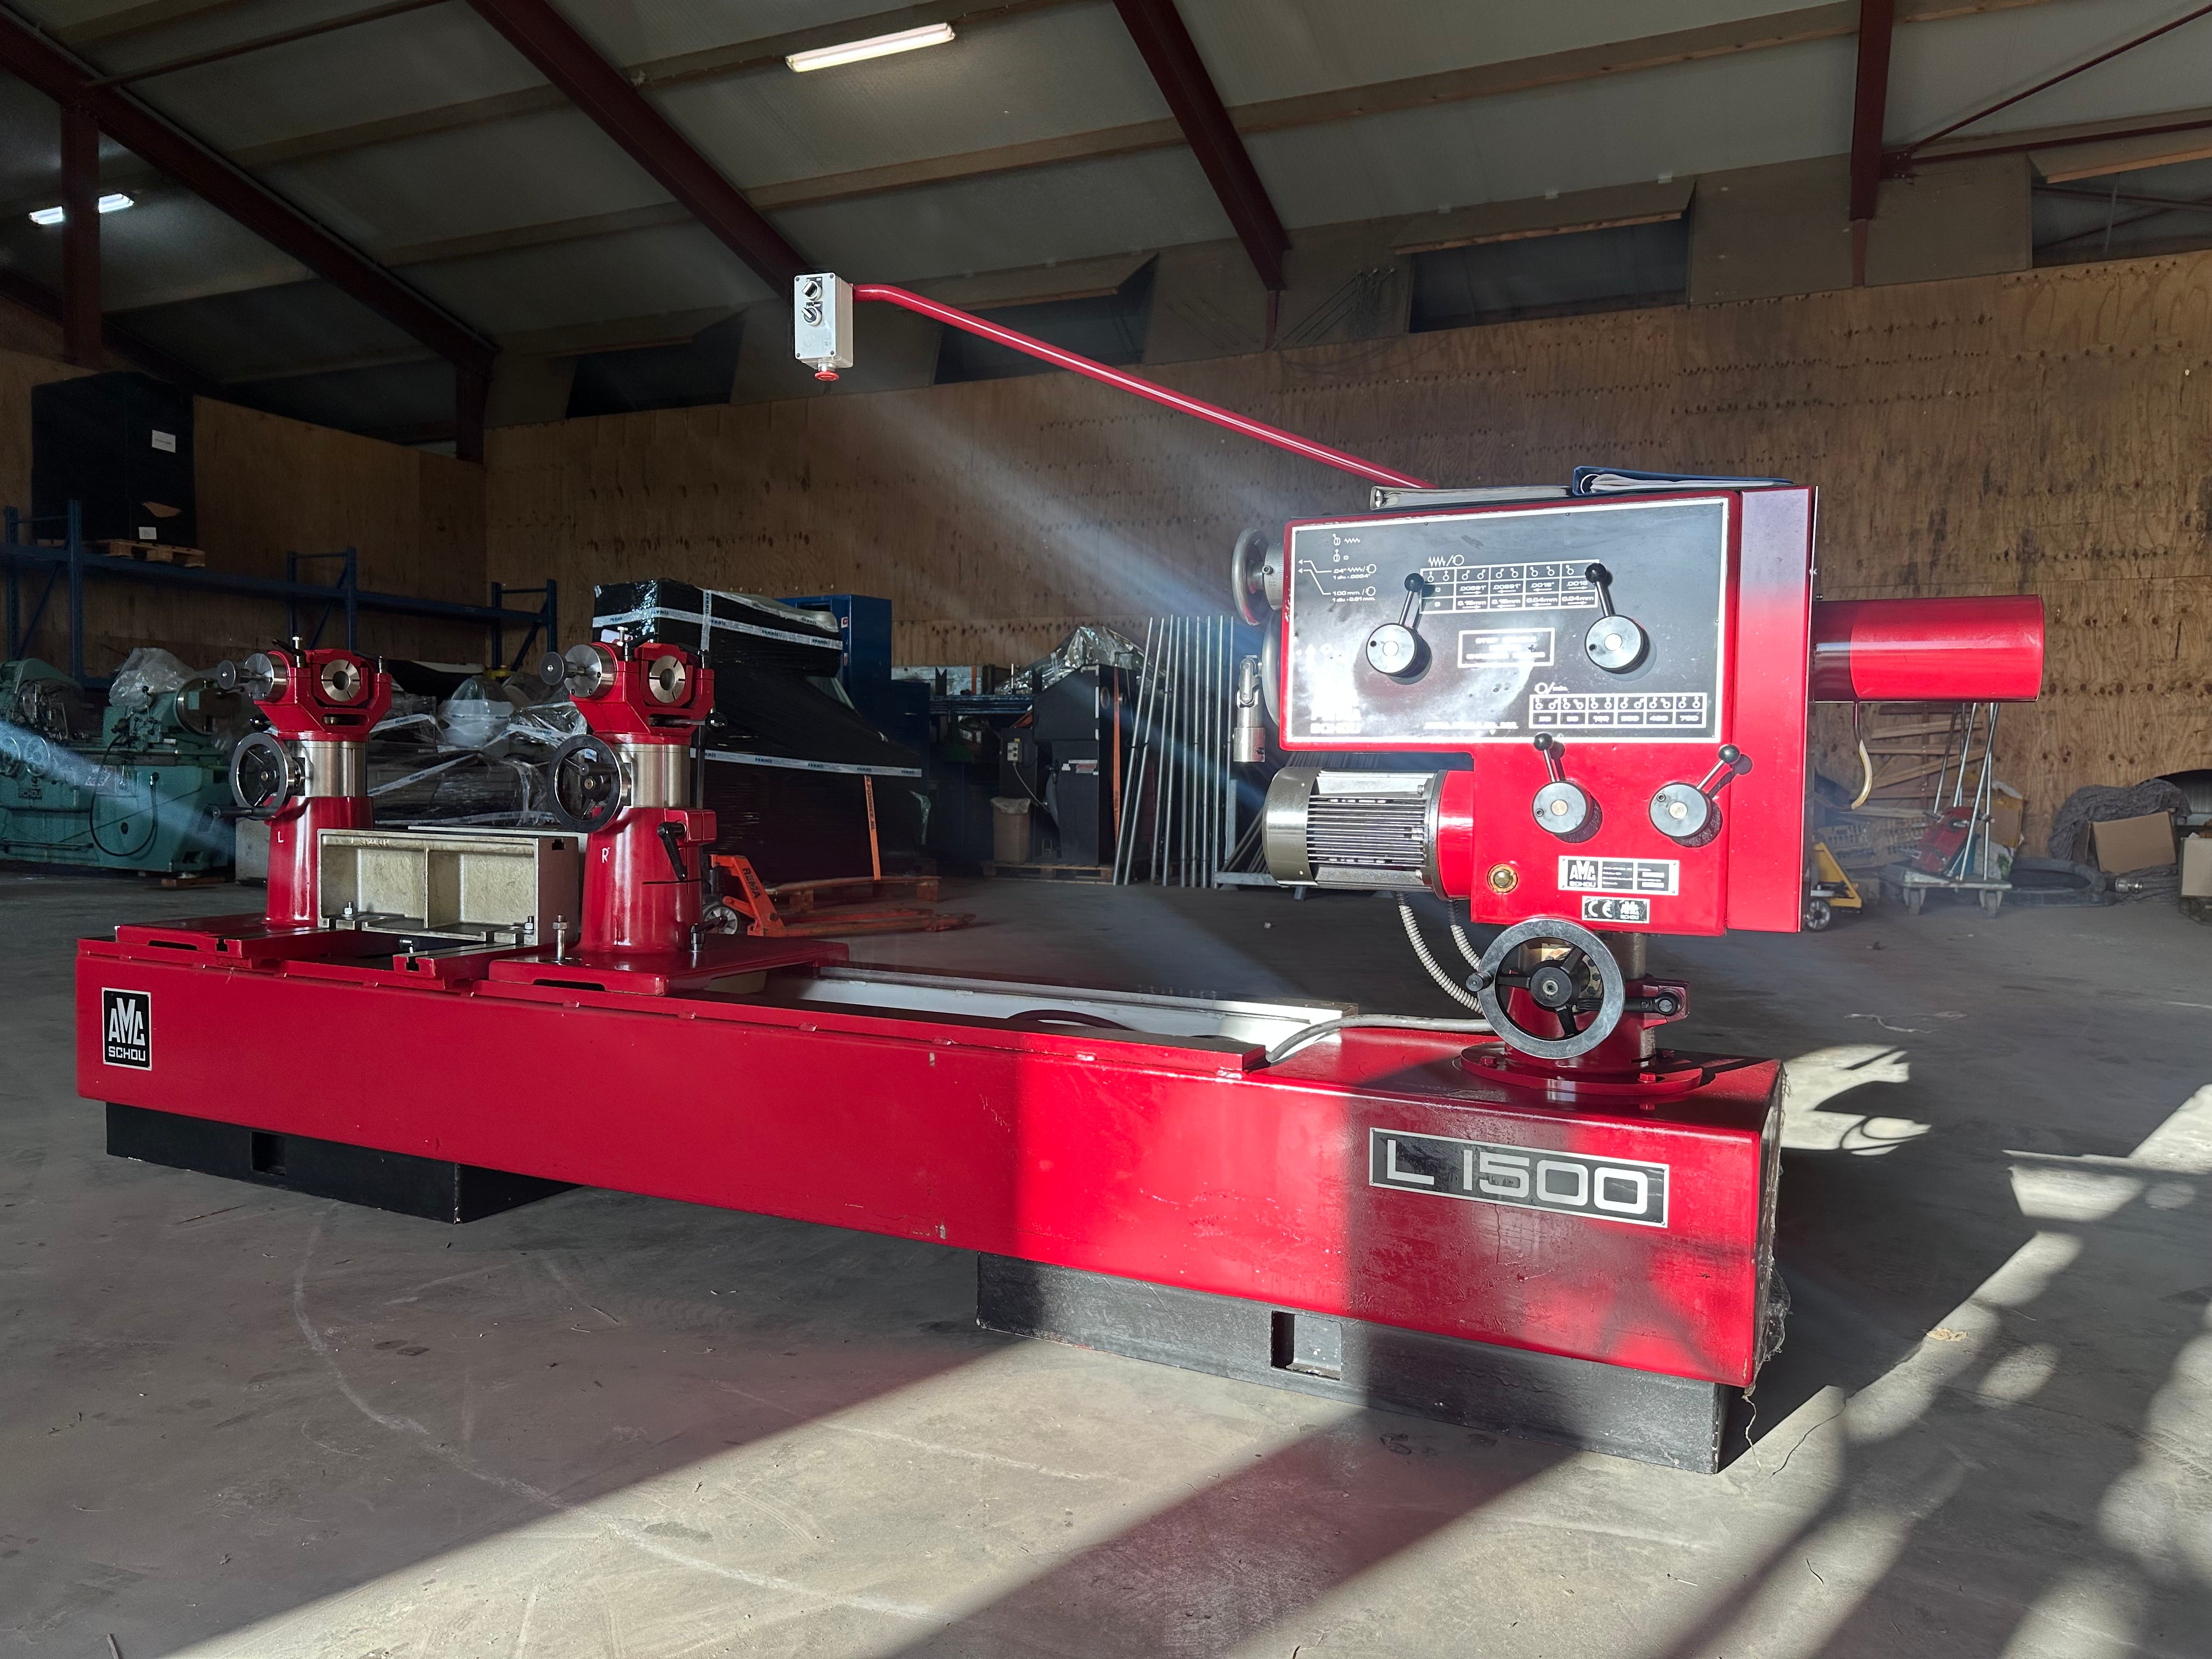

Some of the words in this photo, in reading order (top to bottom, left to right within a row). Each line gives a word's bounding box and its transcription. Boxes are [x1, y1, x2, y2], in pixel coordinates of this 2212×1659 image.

[278, 831, 284, 843] L
[108, 997, 145, 1046] AMC
[108, 1046, 146, 1062] SCHOU
[1387, 1139, 1435, 1186] L
[1463, 1149, 1649, 1215] 1500
